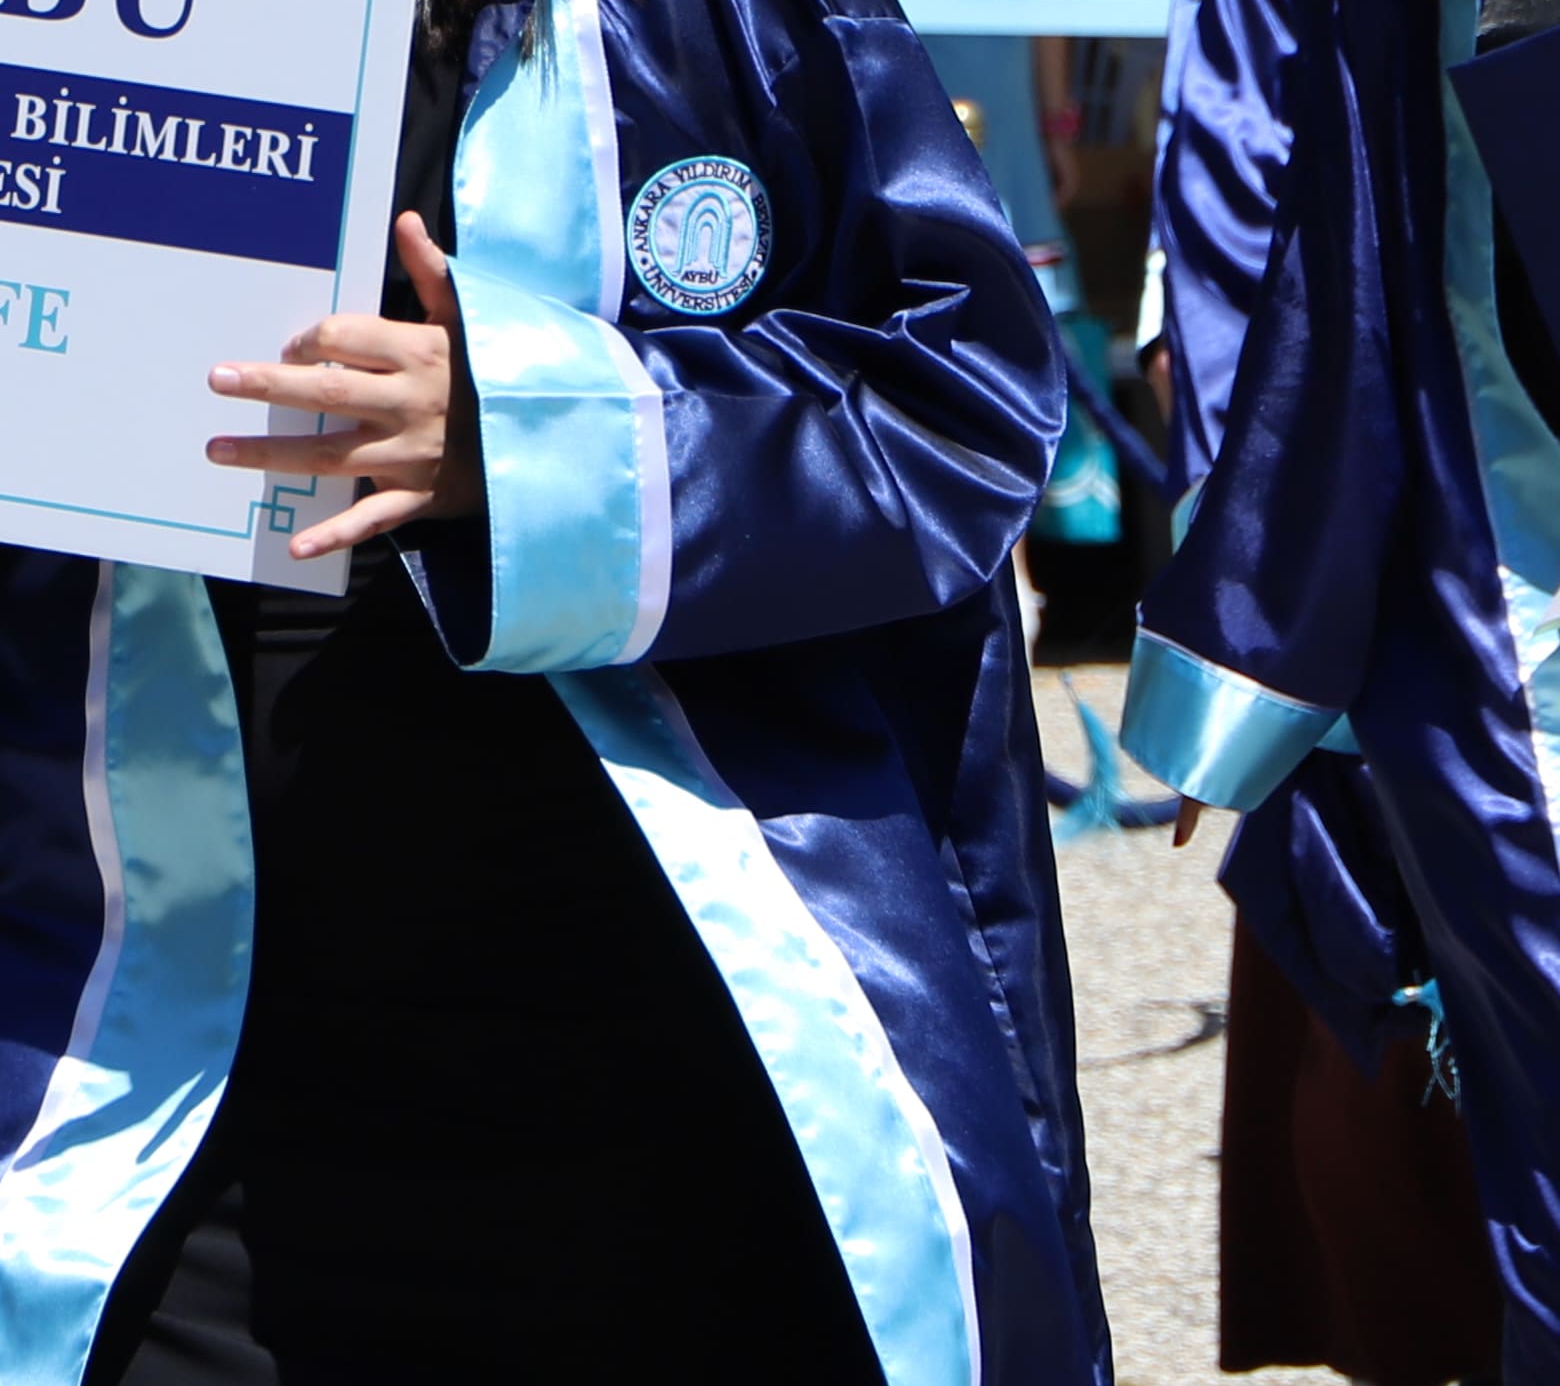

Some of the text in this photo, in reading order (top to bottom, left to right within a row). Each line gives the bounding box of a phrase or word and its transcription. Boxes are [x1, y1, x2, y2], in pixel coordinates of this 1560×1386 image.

[10, 88, 318, 182] BİLİMLERİ
[634, 181, 672, 253] ANKARA
[673, 163, 753, 191] YILDIRIM
